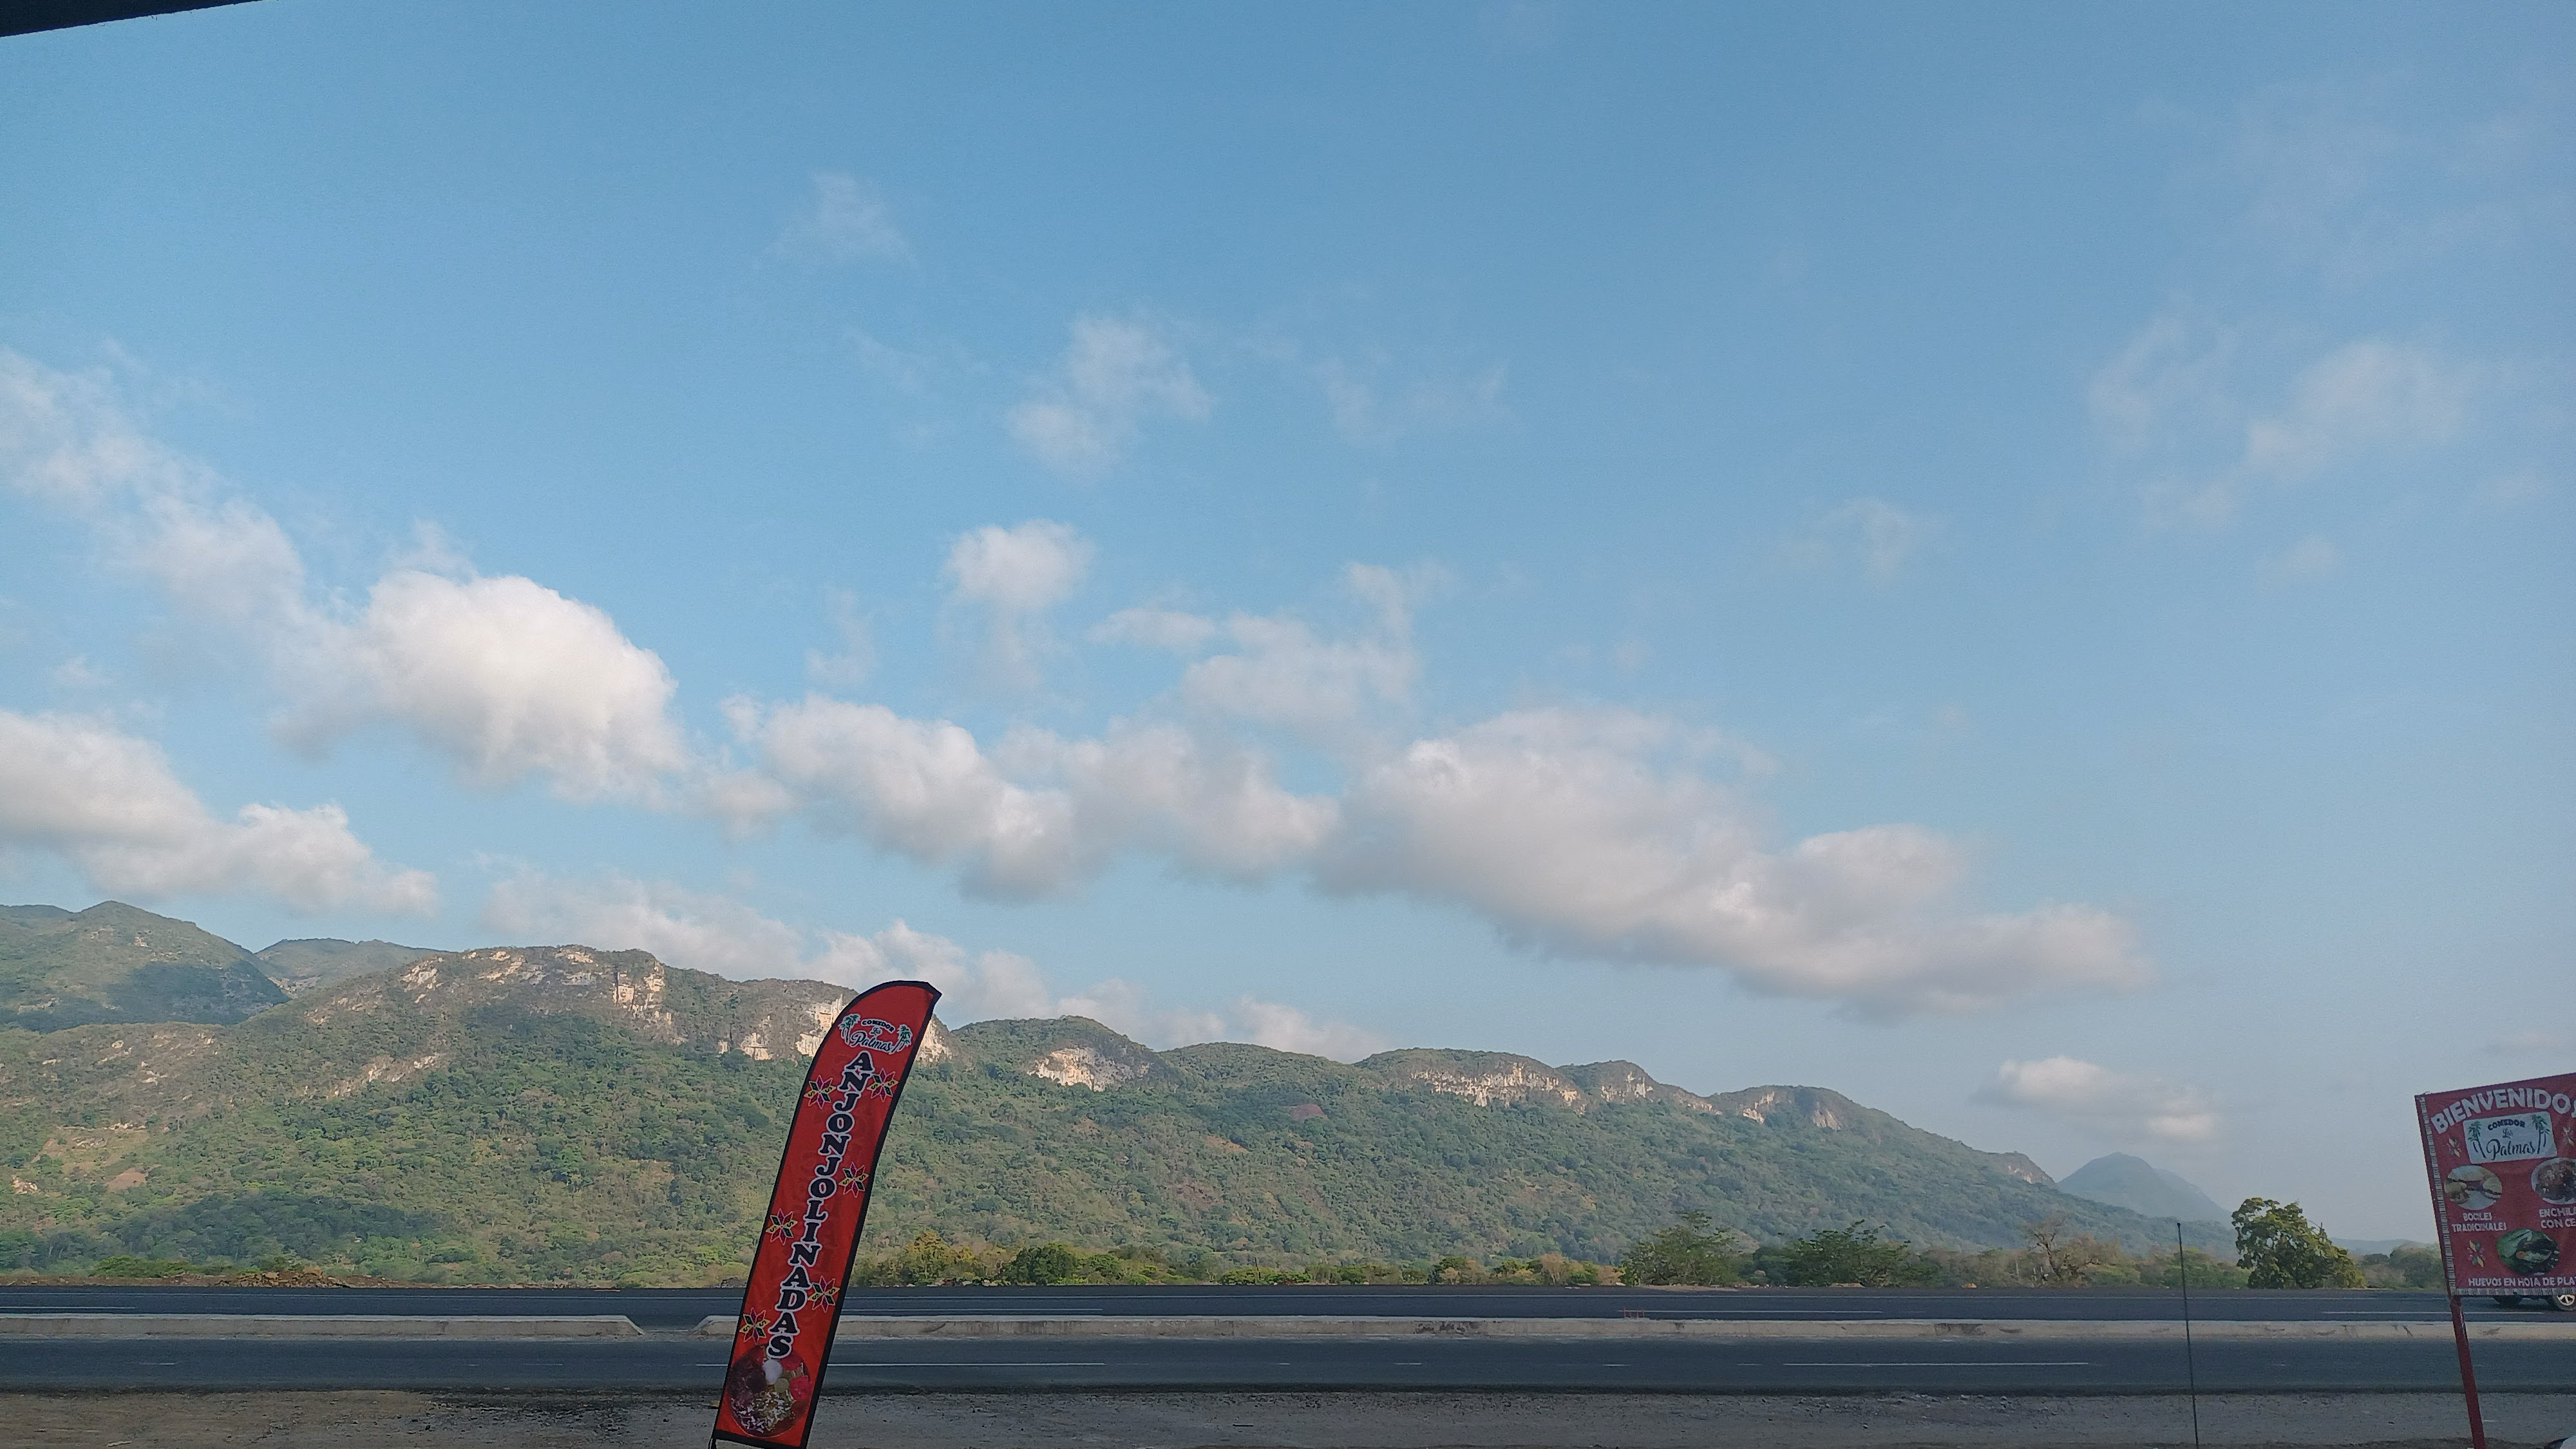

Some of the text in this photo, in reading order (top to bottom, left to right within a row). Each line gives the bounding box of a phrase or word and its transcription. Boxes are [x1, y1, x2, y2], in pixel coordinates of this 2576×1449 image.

[862, 1019, 895, 1033] COMEDOR
[850, 1031, 891, 1052] Palmas
[2487, 1119, 2526, 1131] COMEDOR
[2486, 1139, 2535, 1160] Palmas
[766, 1050, 875, 1359] ANJONJOLINADAS
[2541, 1218, 2564, 1229] CON
[2468, 1277, 2503, 1287] HUEVOS
[2503, 1277, 2516, 1287] EN
[2542, 1276, 2555, 1286] DE
[2557, 1276, 2576, 1286] PLA
